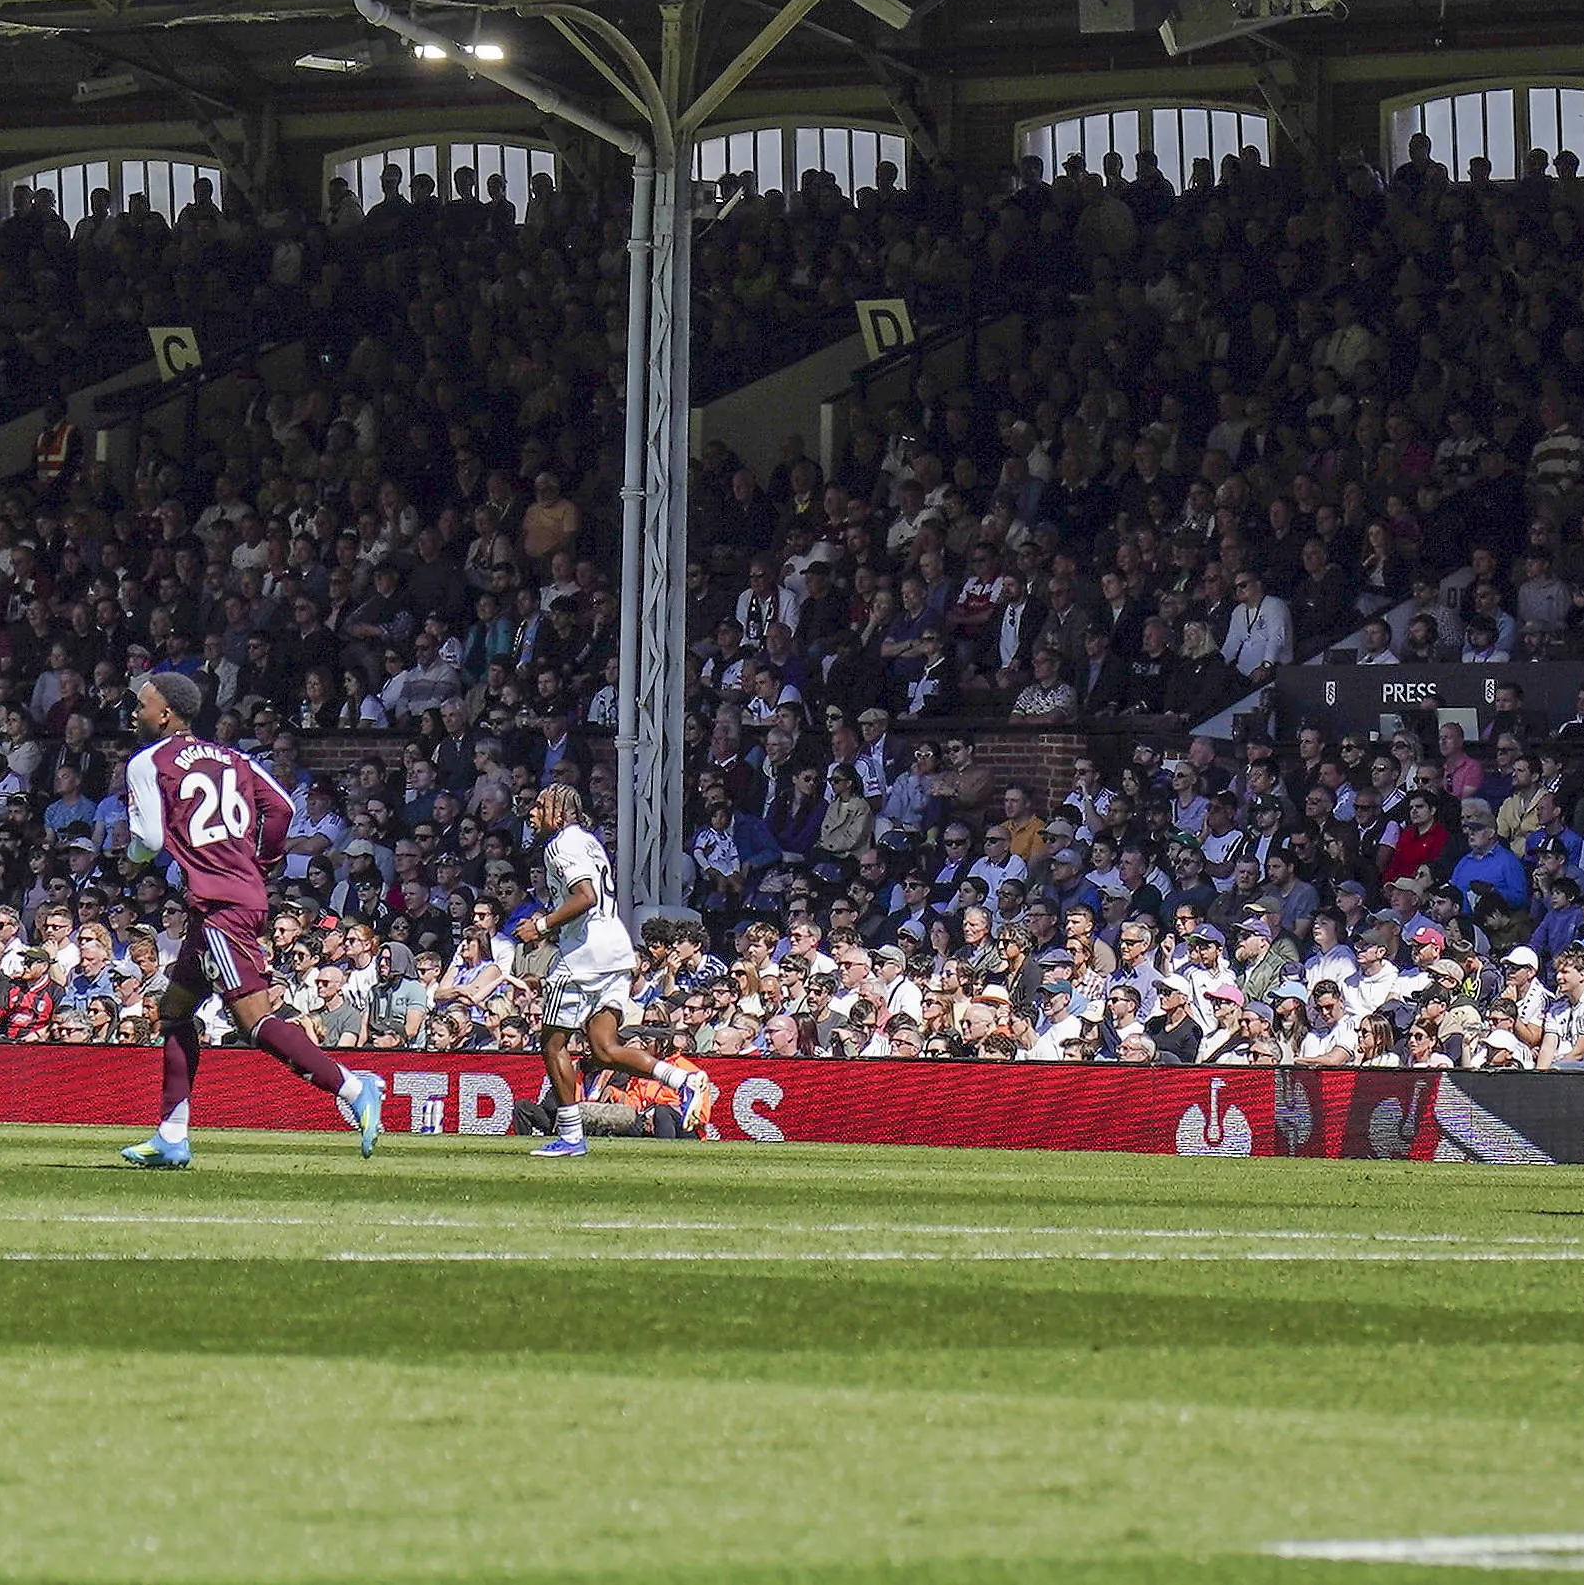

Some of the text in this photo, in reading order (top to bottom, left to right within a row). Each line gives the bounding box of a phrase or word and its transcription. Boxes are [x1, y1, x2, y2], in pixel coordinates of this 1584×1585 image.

[868, 309, 904, 353] D
[162, 335, 193, 375] C
[1382, 682, 1438, 704] PRESS
[178, 767, 251, 848] 26
[198, 950, 221, 981] 6
